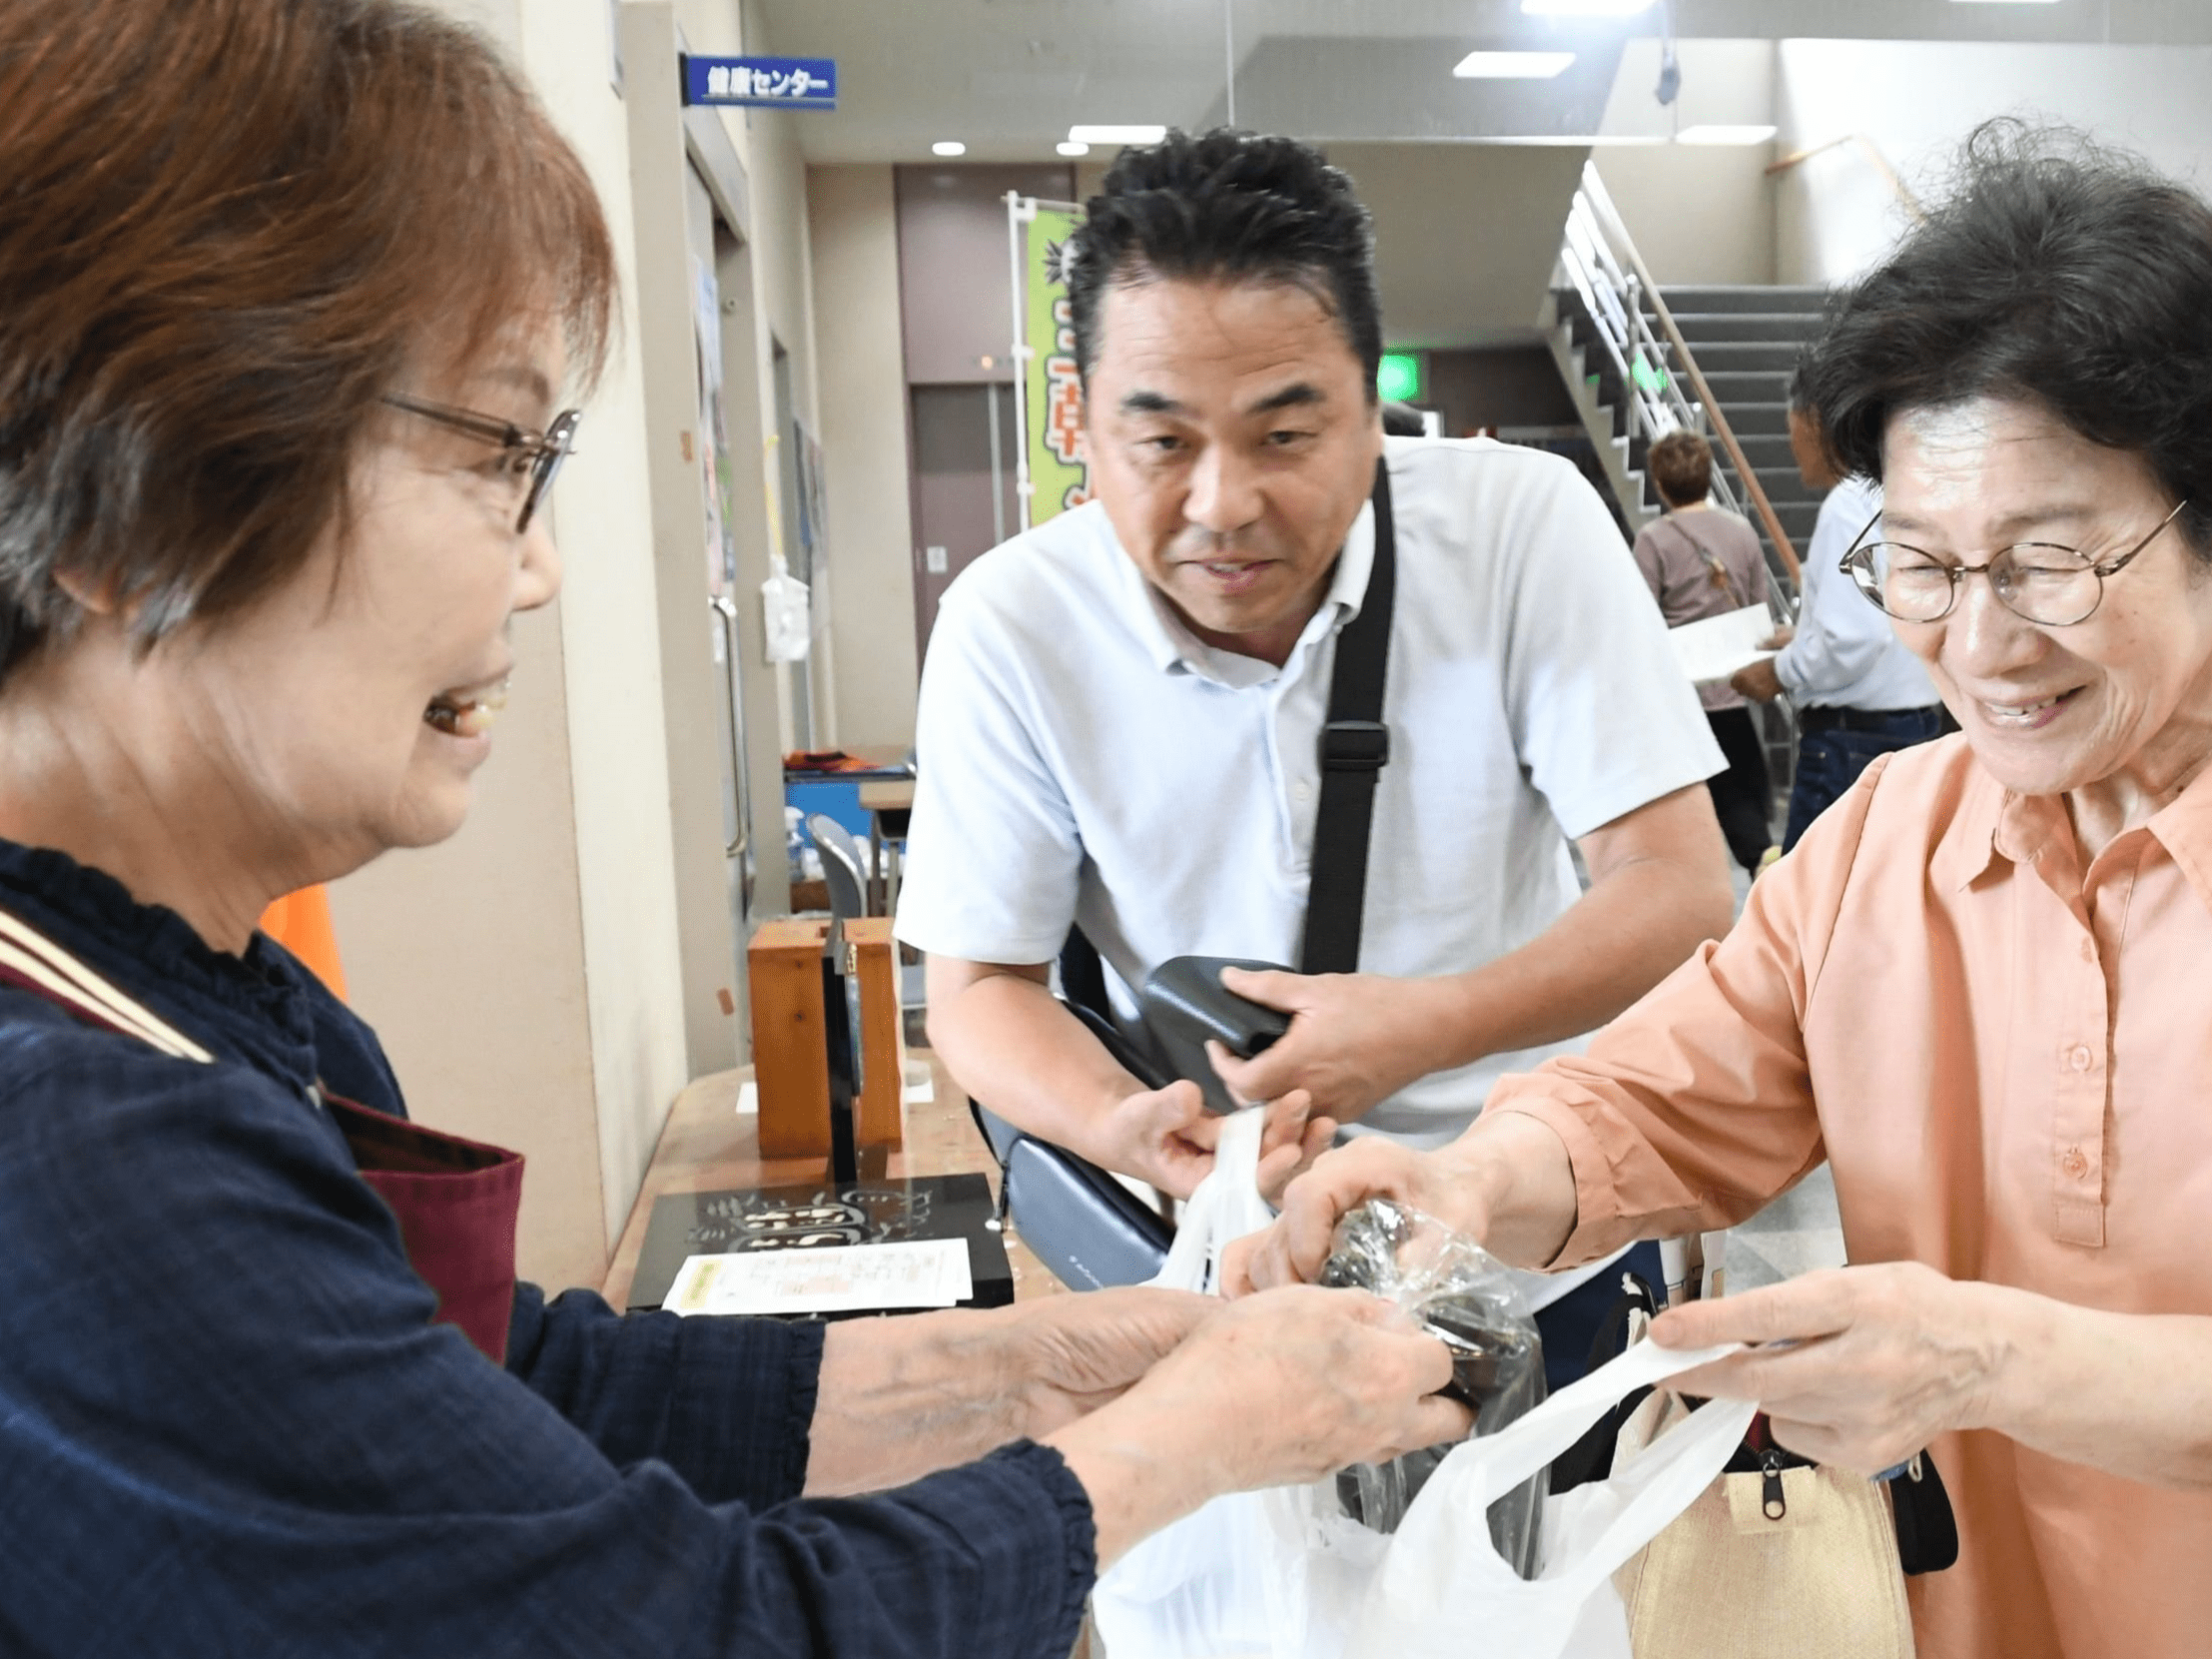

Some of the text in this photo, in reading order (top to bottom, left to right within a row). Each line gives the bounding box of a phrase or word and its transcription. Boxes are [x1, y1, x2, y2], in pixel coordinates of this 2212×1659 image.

[708, 66, 828, 97] 健康センター
